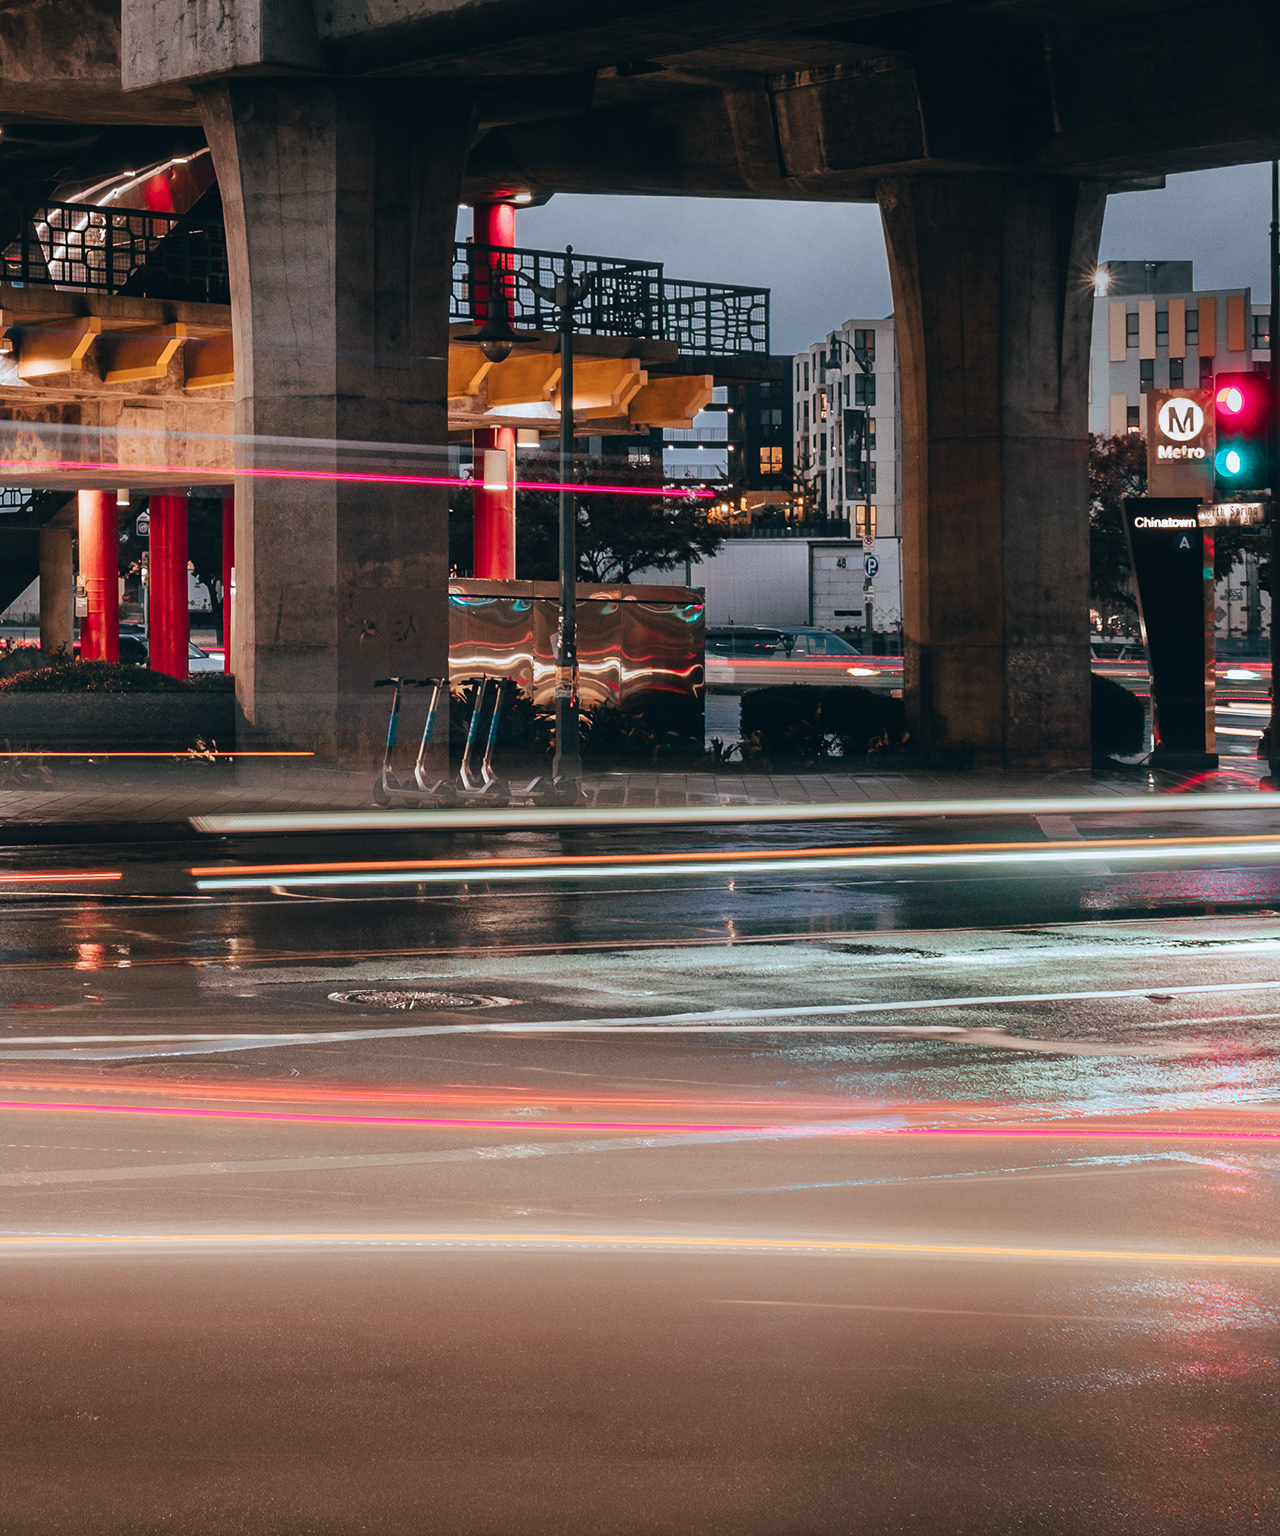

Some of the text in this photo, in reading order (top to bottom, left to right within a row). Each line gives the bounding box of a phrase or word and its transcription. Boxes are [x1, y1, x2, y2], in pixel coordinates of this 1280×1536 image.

[1168, 406, 1194, 434] M
[1157, 445, 1206, 460] Metro
[1229, 505, 1259, 518] Spring
[1134, 516, 1197, 529] Chinatown
[1179, 536, 1191, 549] A
[836, 557, 847, 569] 48
